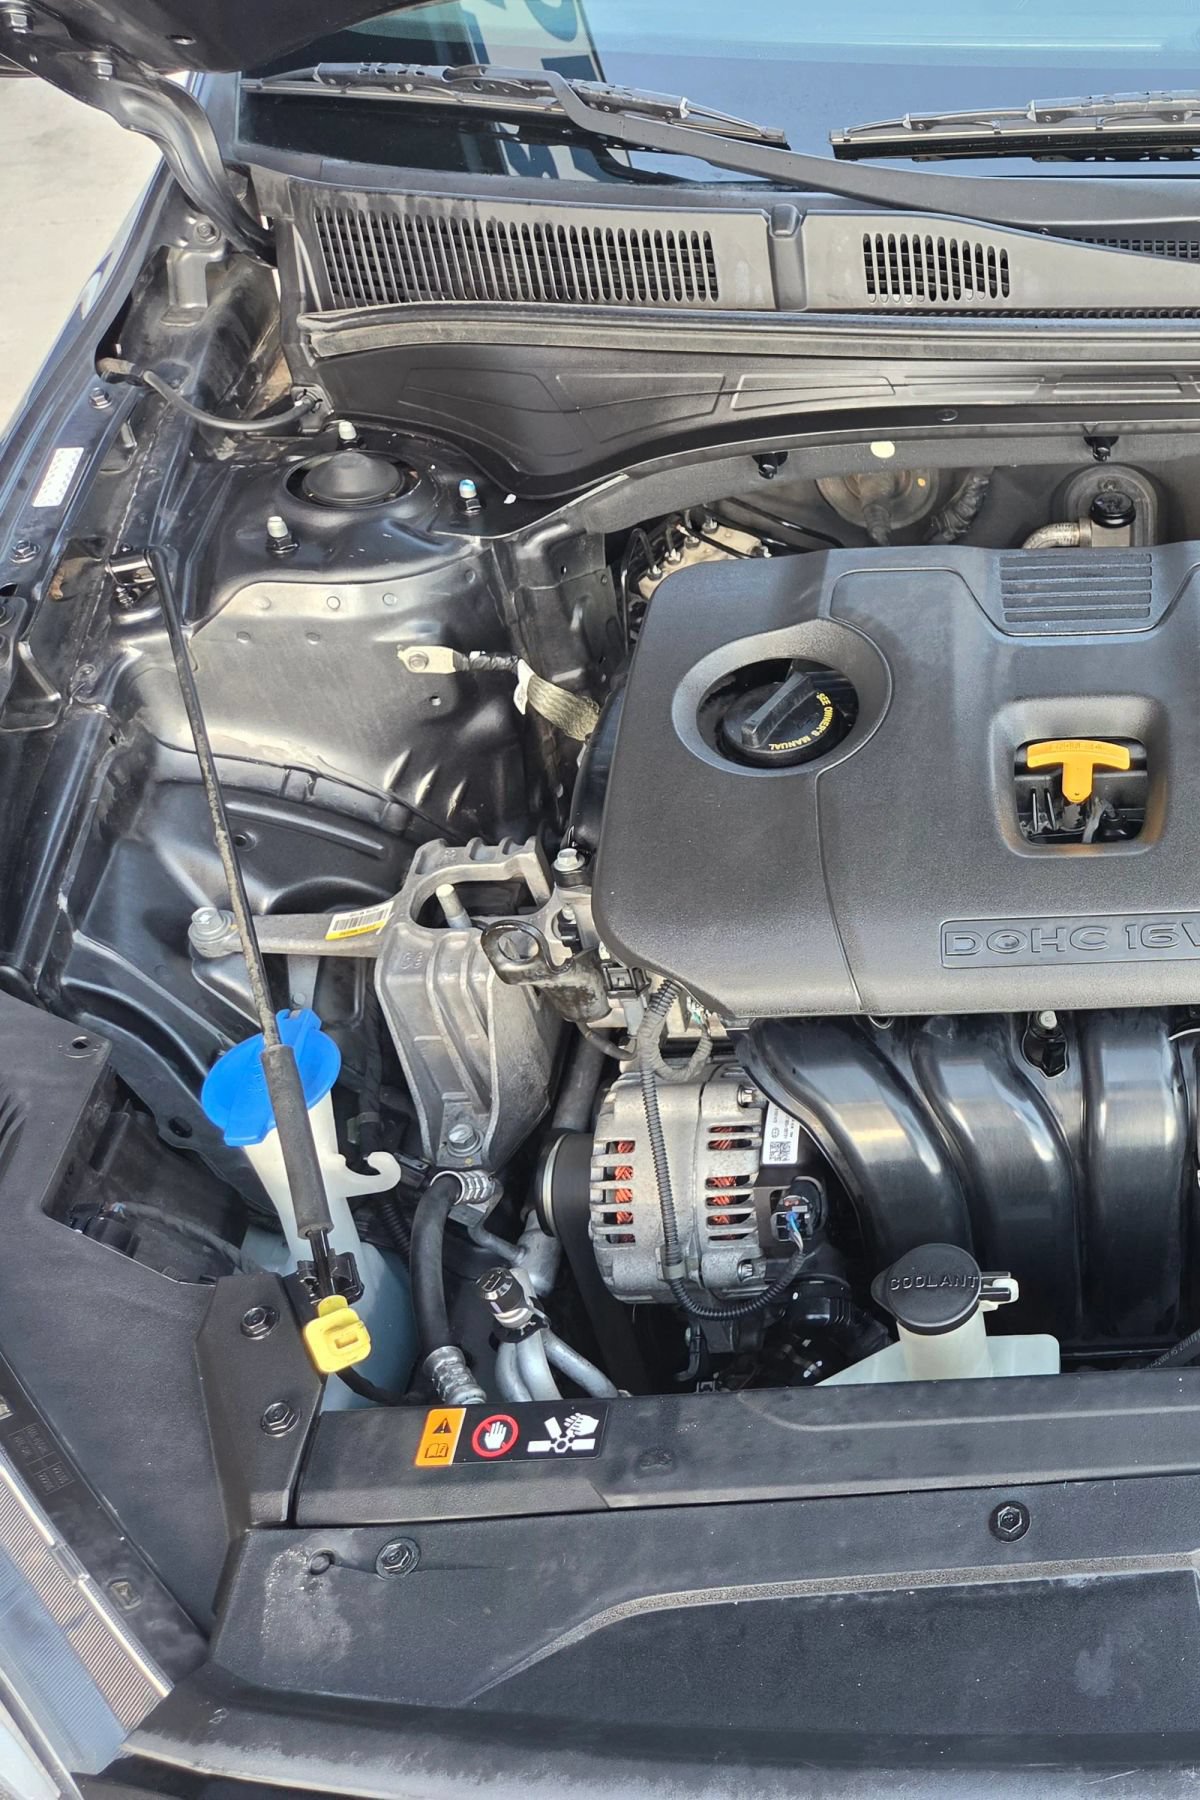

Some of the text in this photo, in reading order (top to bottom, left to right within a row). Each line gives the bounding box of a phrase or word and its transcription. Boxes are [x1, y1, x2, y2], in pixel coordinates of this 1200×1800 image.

[769, 735, 811, 751] MANUAL
[945, 925, 1110, 956] DOHC
[890, 1274, 979, 1291] COOLANT
